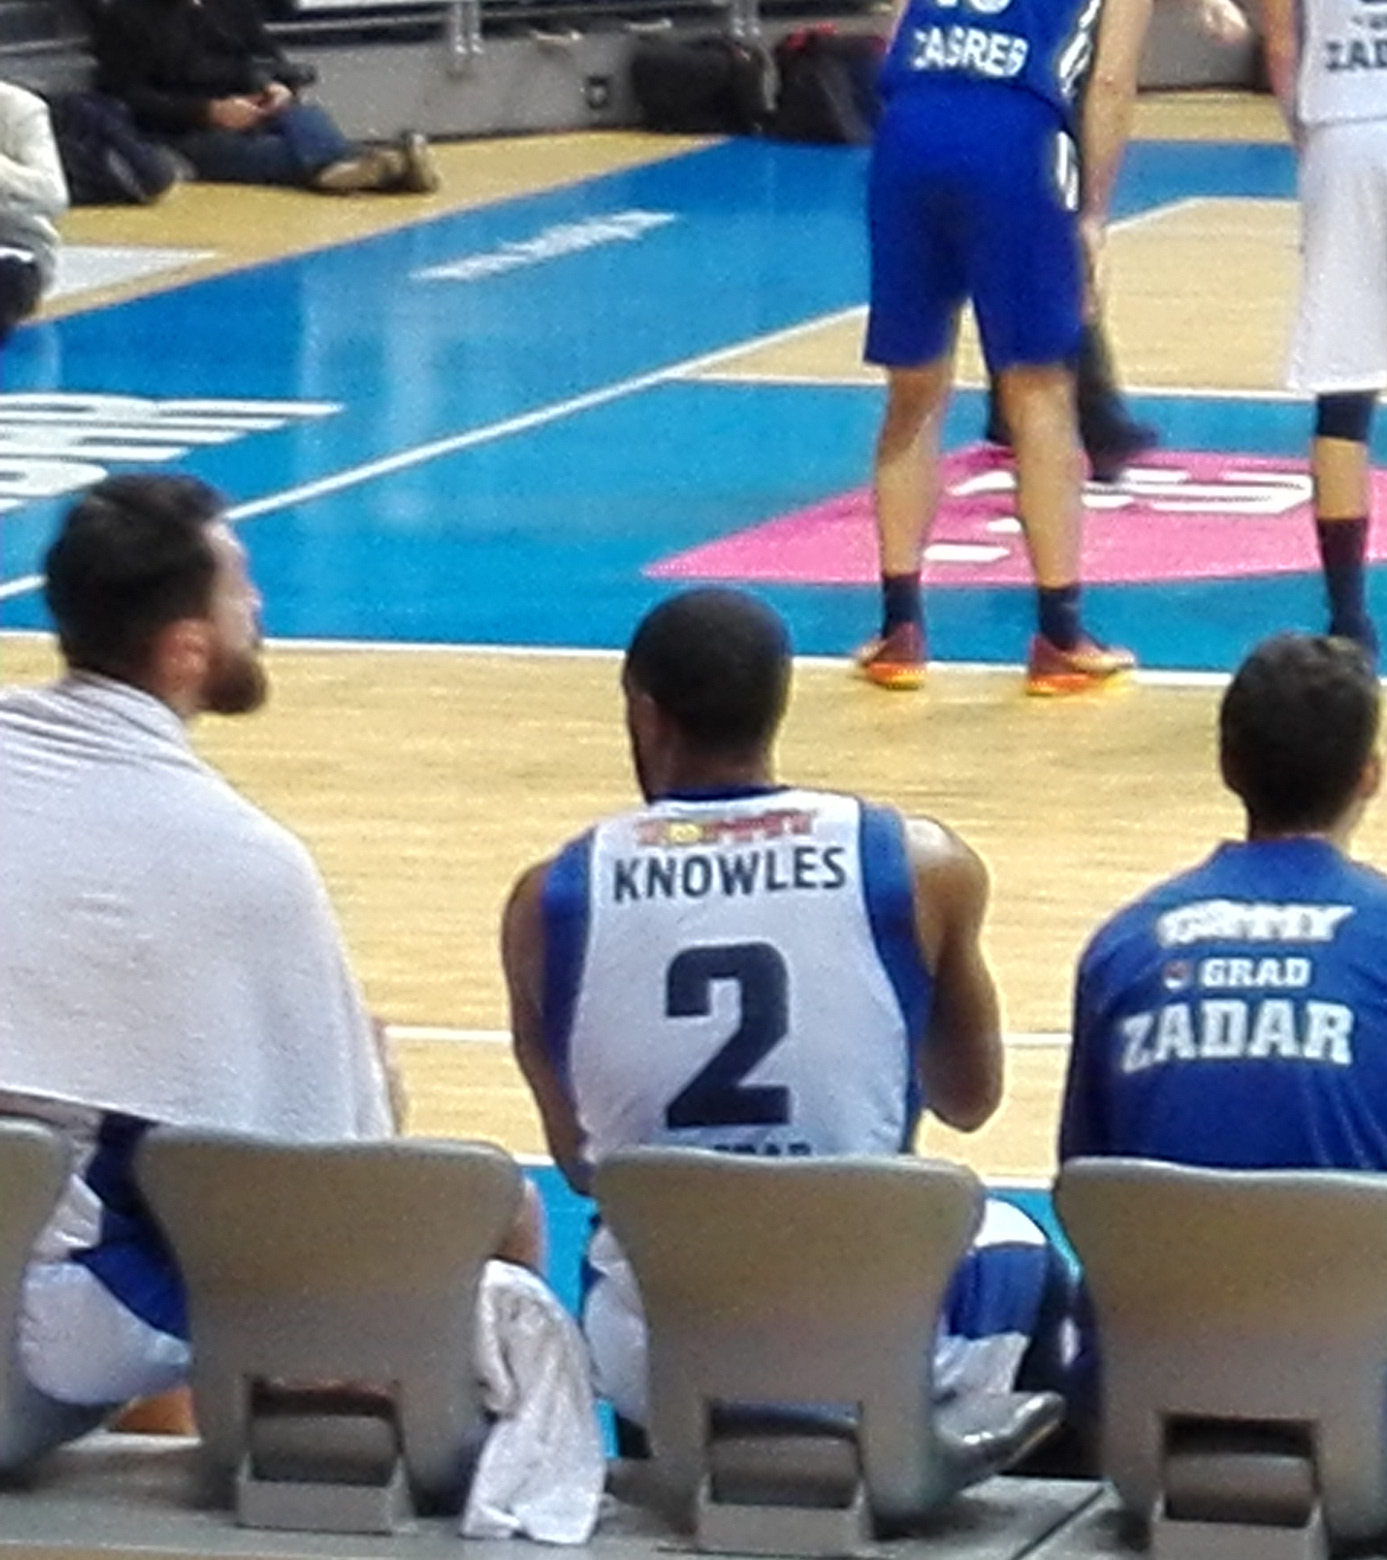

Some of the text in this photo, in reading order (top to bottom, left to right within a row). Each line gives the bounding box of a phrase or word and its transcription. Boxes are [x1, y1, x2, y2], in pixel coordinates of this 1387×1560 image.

[613, 845, 848, 903] KNOWLES
[1202, 957, 1311, 988] GRAD
[665, 940, 791, 1130] 2
[1121, 998, 1355, 1074] ZADAR
